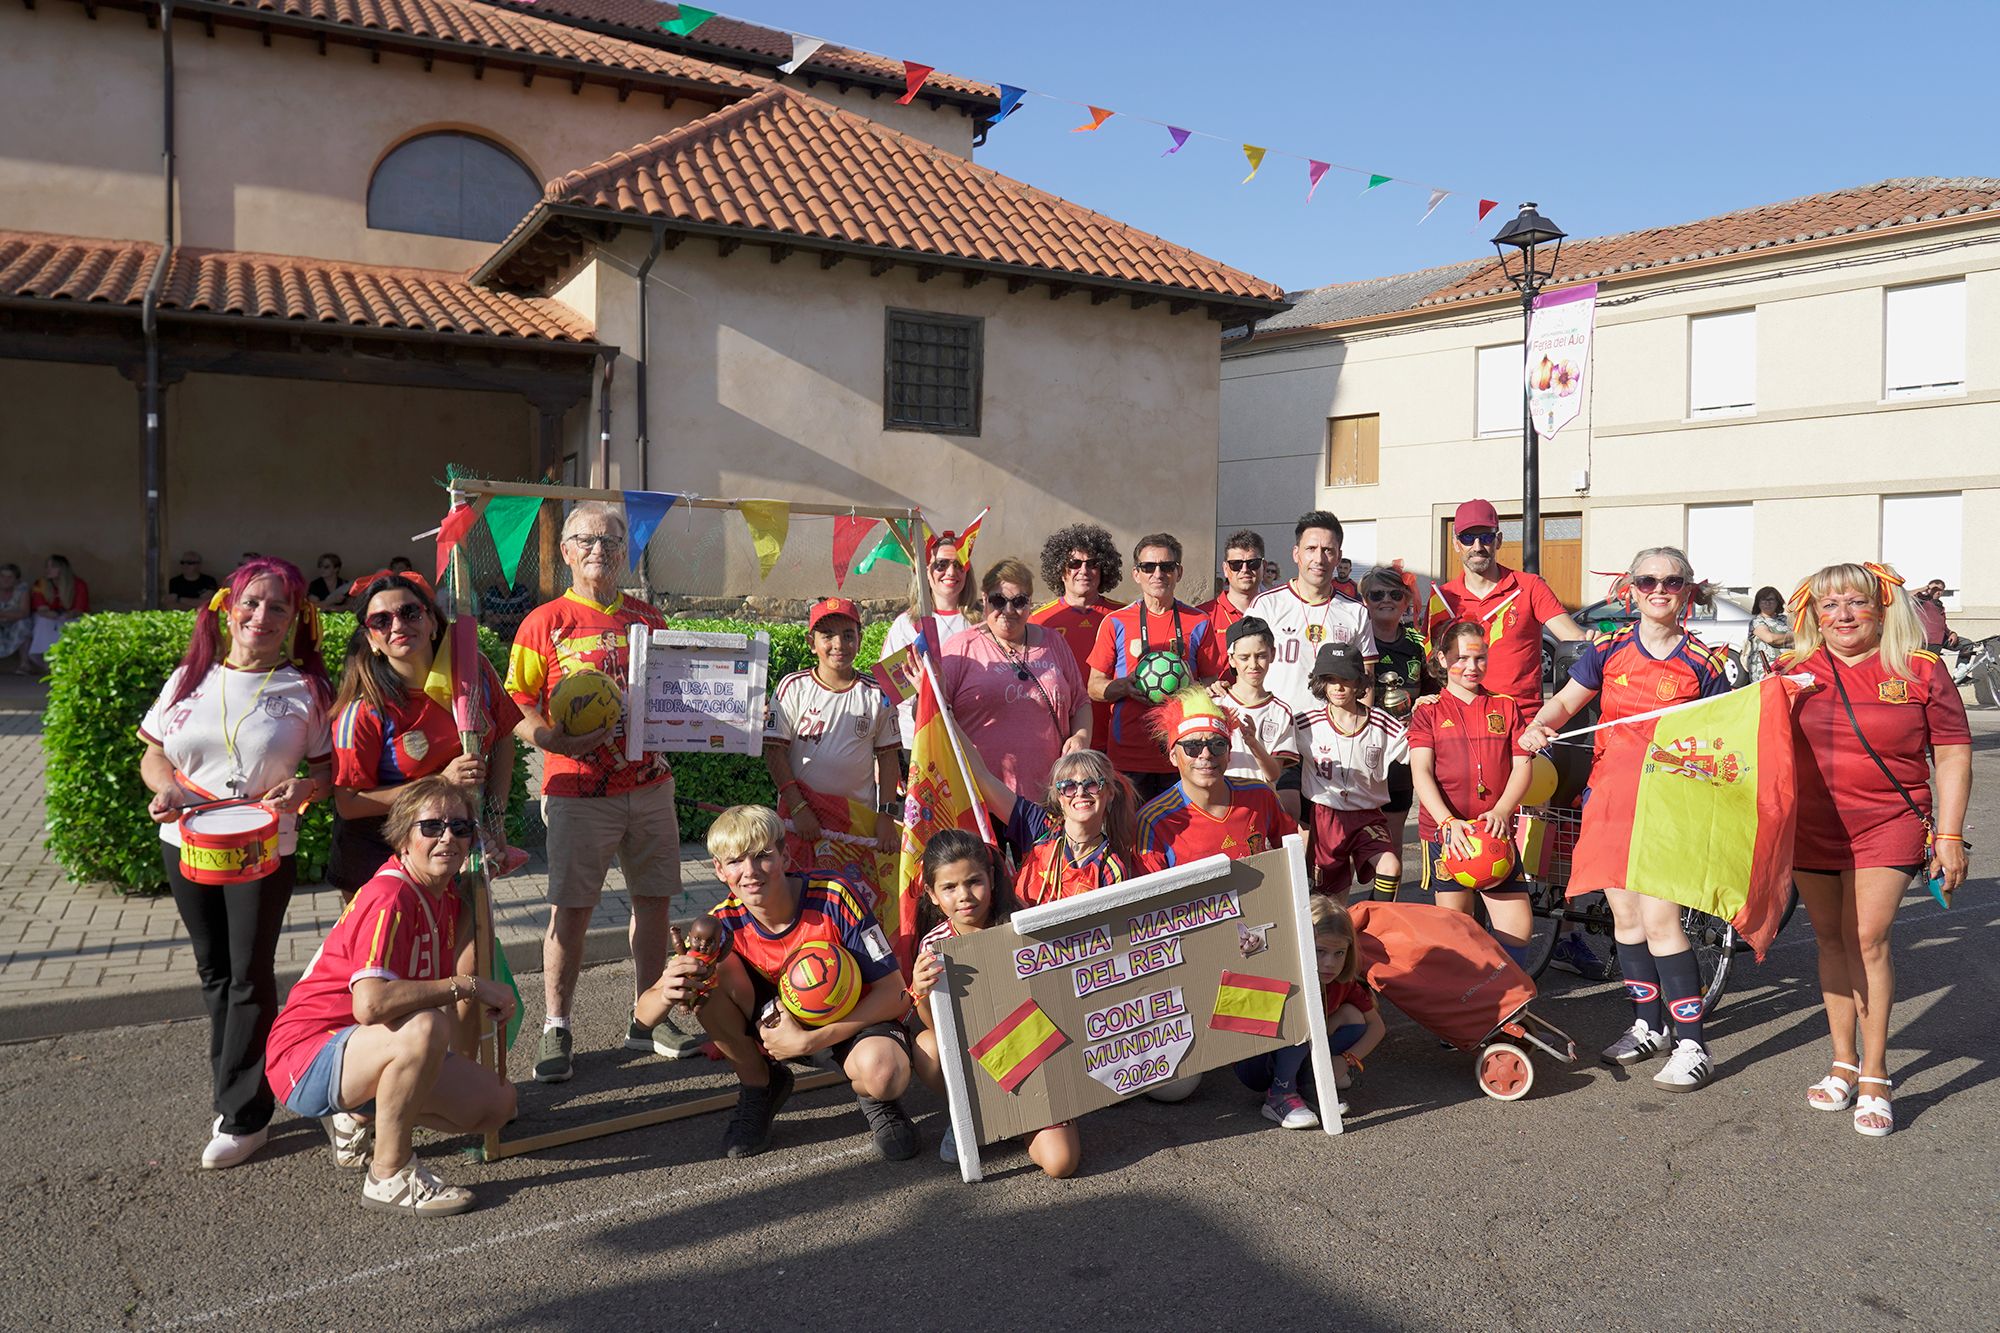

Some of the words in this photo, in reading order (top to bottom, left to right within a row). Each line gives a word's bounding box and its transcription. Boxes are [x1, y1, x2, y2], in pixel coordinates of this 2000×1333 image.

[1278, 638, 1300, 664] 10
[662, 681, 711, 695] PAUSA
[714, 682, 734, 695] DE
[648, 698, 746, 714] HIDRATACIÓN
[798, 716, 826, 745] 24
[1313, 756, 1333, 780] 19
[1016, 928, 1111, 975] SANTA
[1127, 893, 1237, 943] MARINA
[1075, 959, 1125, 995] DEL
[1129, 938, 1179, 976] REY
[1087, 1000, 1145, 1038] CON
[1150, 991, 1183, 1018] EL
[1083, 1020, 1191, 1072] MUNDIAL
[1114, 1055, 1170, 1092] 2026
